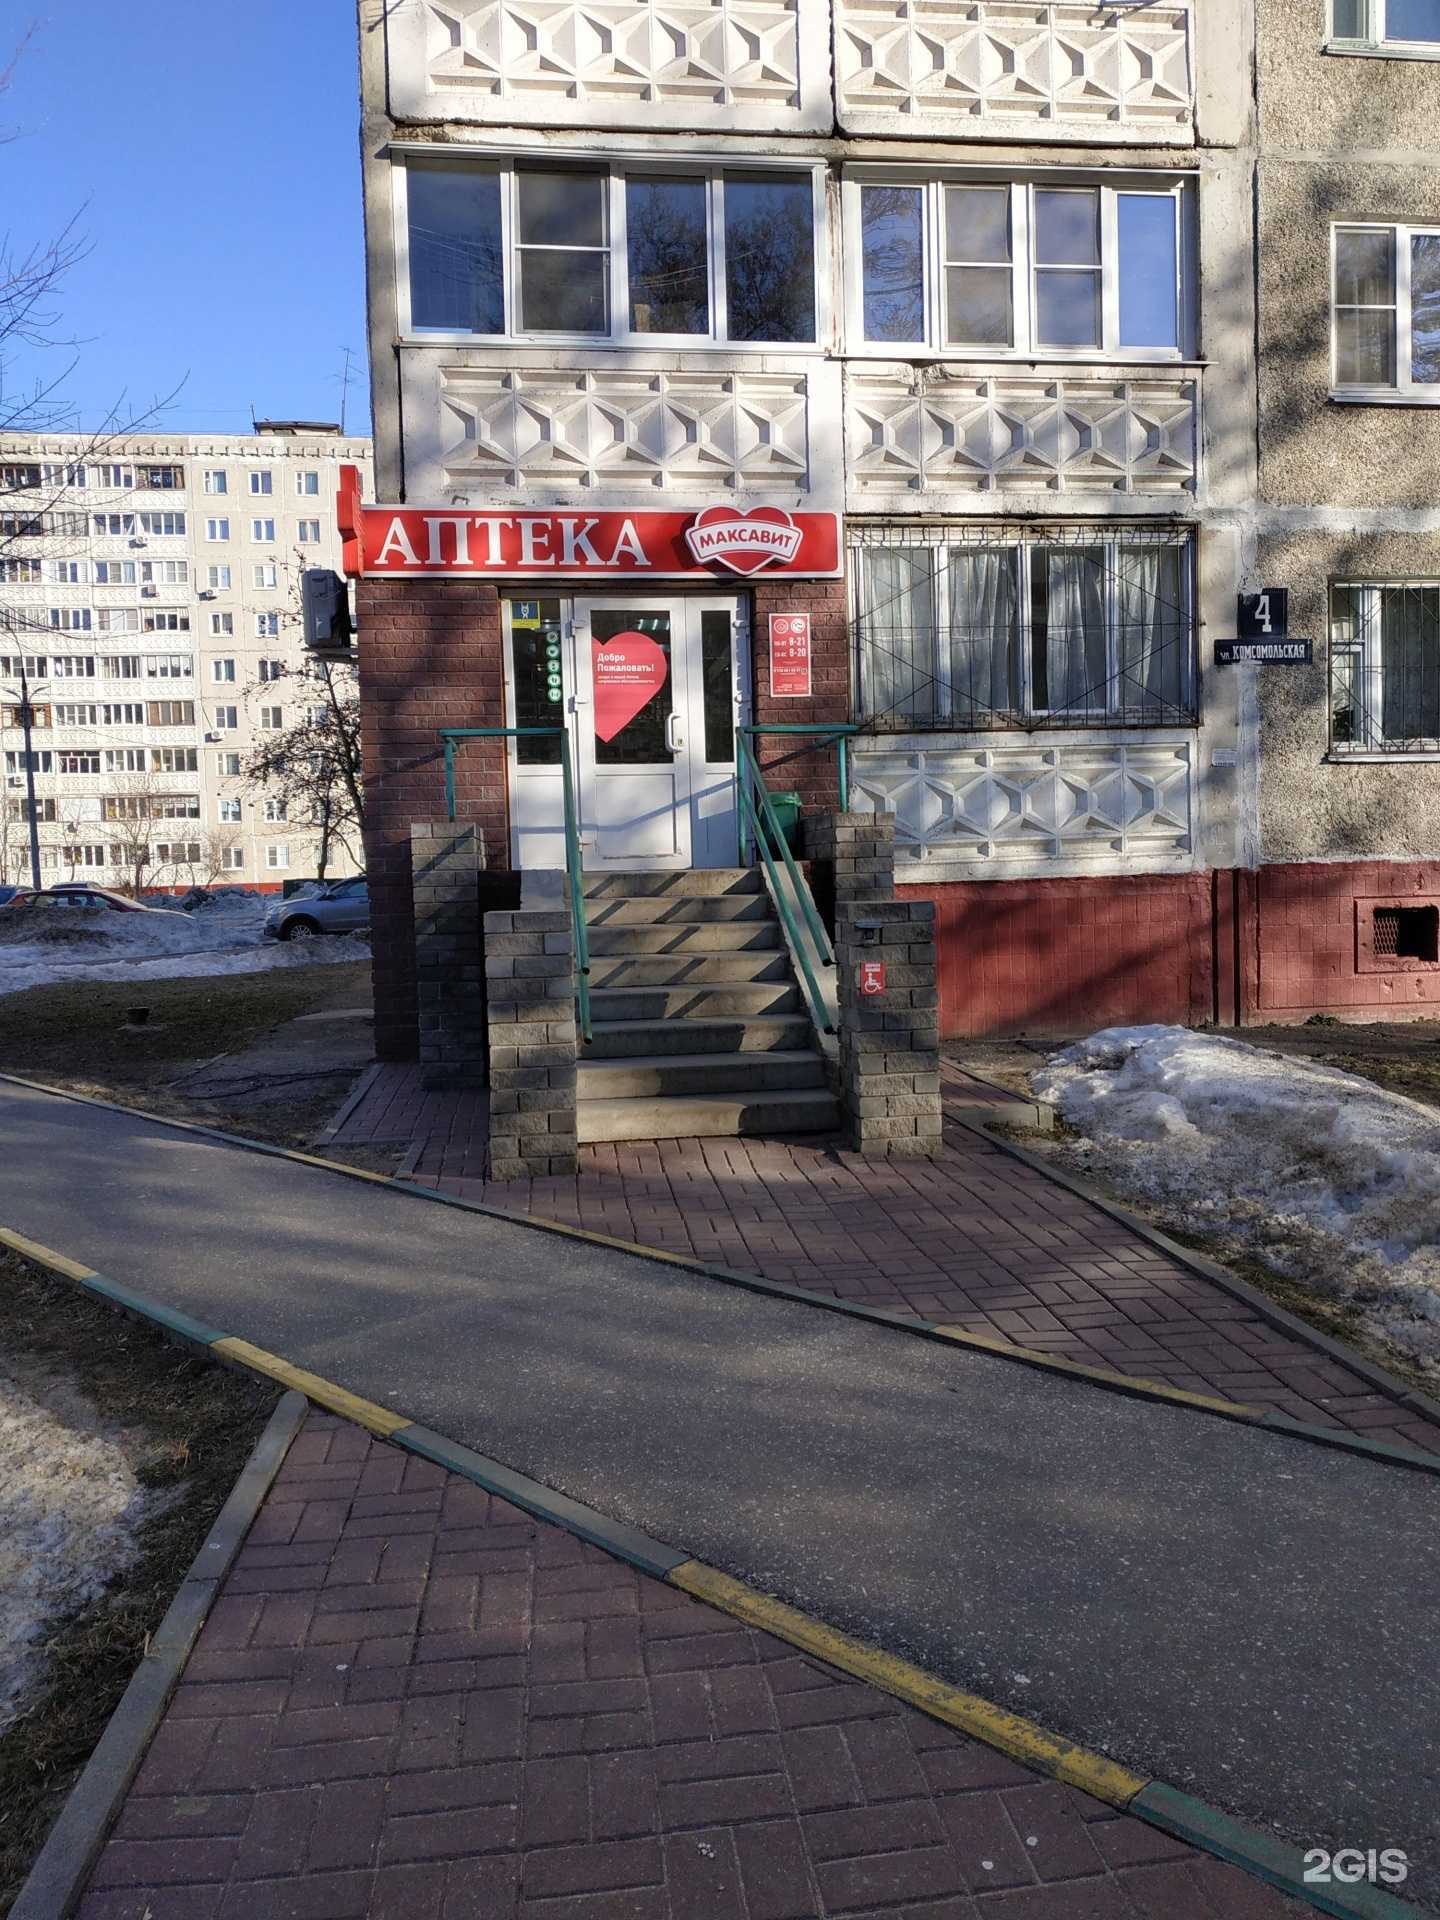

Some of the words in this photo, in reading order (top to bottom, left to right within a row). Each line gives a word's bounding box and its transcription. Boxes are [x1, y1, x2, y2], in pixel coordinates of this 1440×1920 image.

[374, 517, 652, 567] АПТЕКА
[699, 528, 793, 549] МАКСАВИТ
[1254, 594, 1272, 633] 4
[597, 653, 625, 662] Добро
[1232, 644, 1306, 660] КОМСОМОЛЬСКАЯ
[597, 663, 655, 672] Пожаловать!
